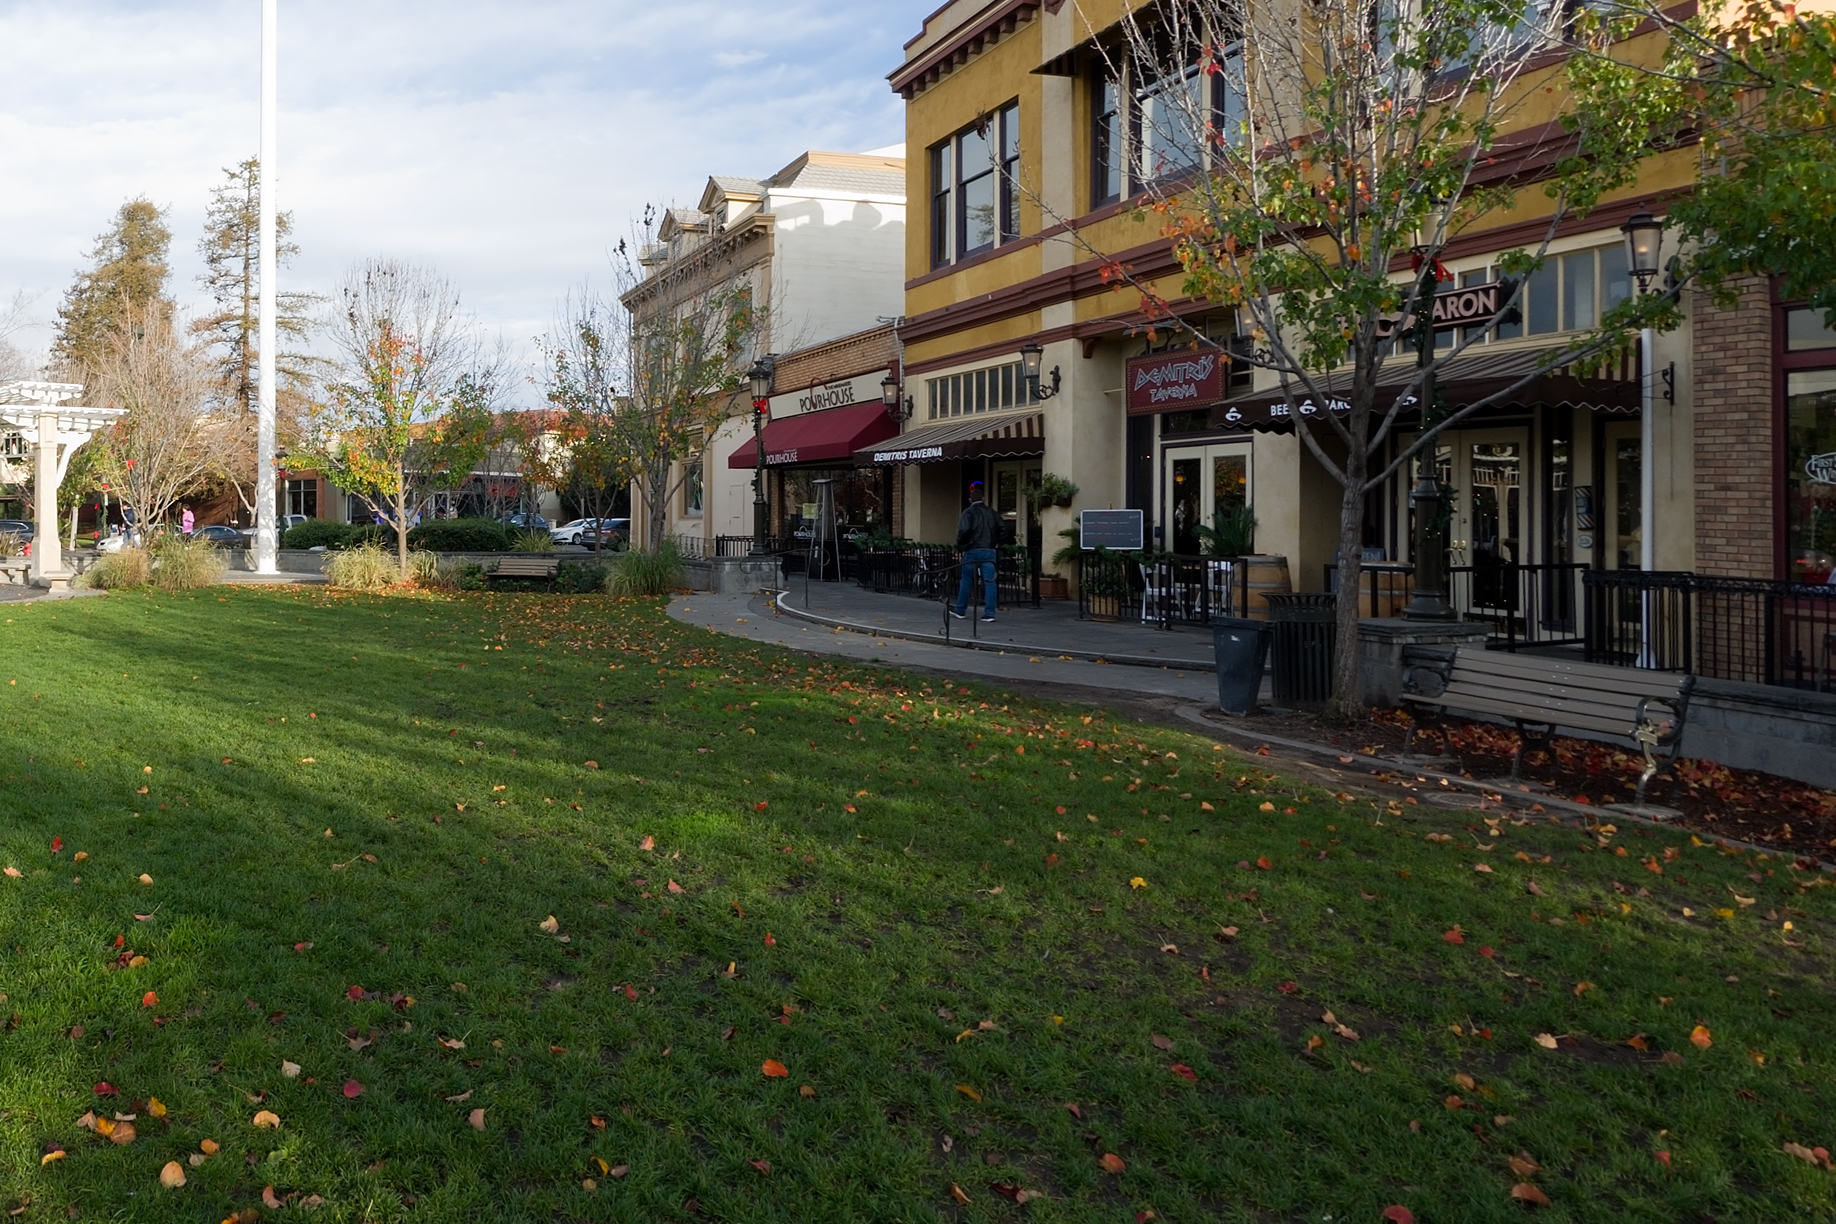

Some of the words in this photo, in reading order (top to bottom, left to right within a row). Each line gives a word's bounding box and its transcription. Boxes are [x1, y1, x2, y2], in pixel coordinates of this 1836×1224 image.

[1432, 289, 1495, 320] ARON
[799, 386, 855, 412] POURHOUSE
[1150, 383, 1197, 403] TAVERNA
[1270, 404, 1291, 416] BEE
[766, 451, 797, 465] POURHOUSE
[874, 450, 907, 462] DEMITRIS
[908, 447, 942, 459] TAVERNA
